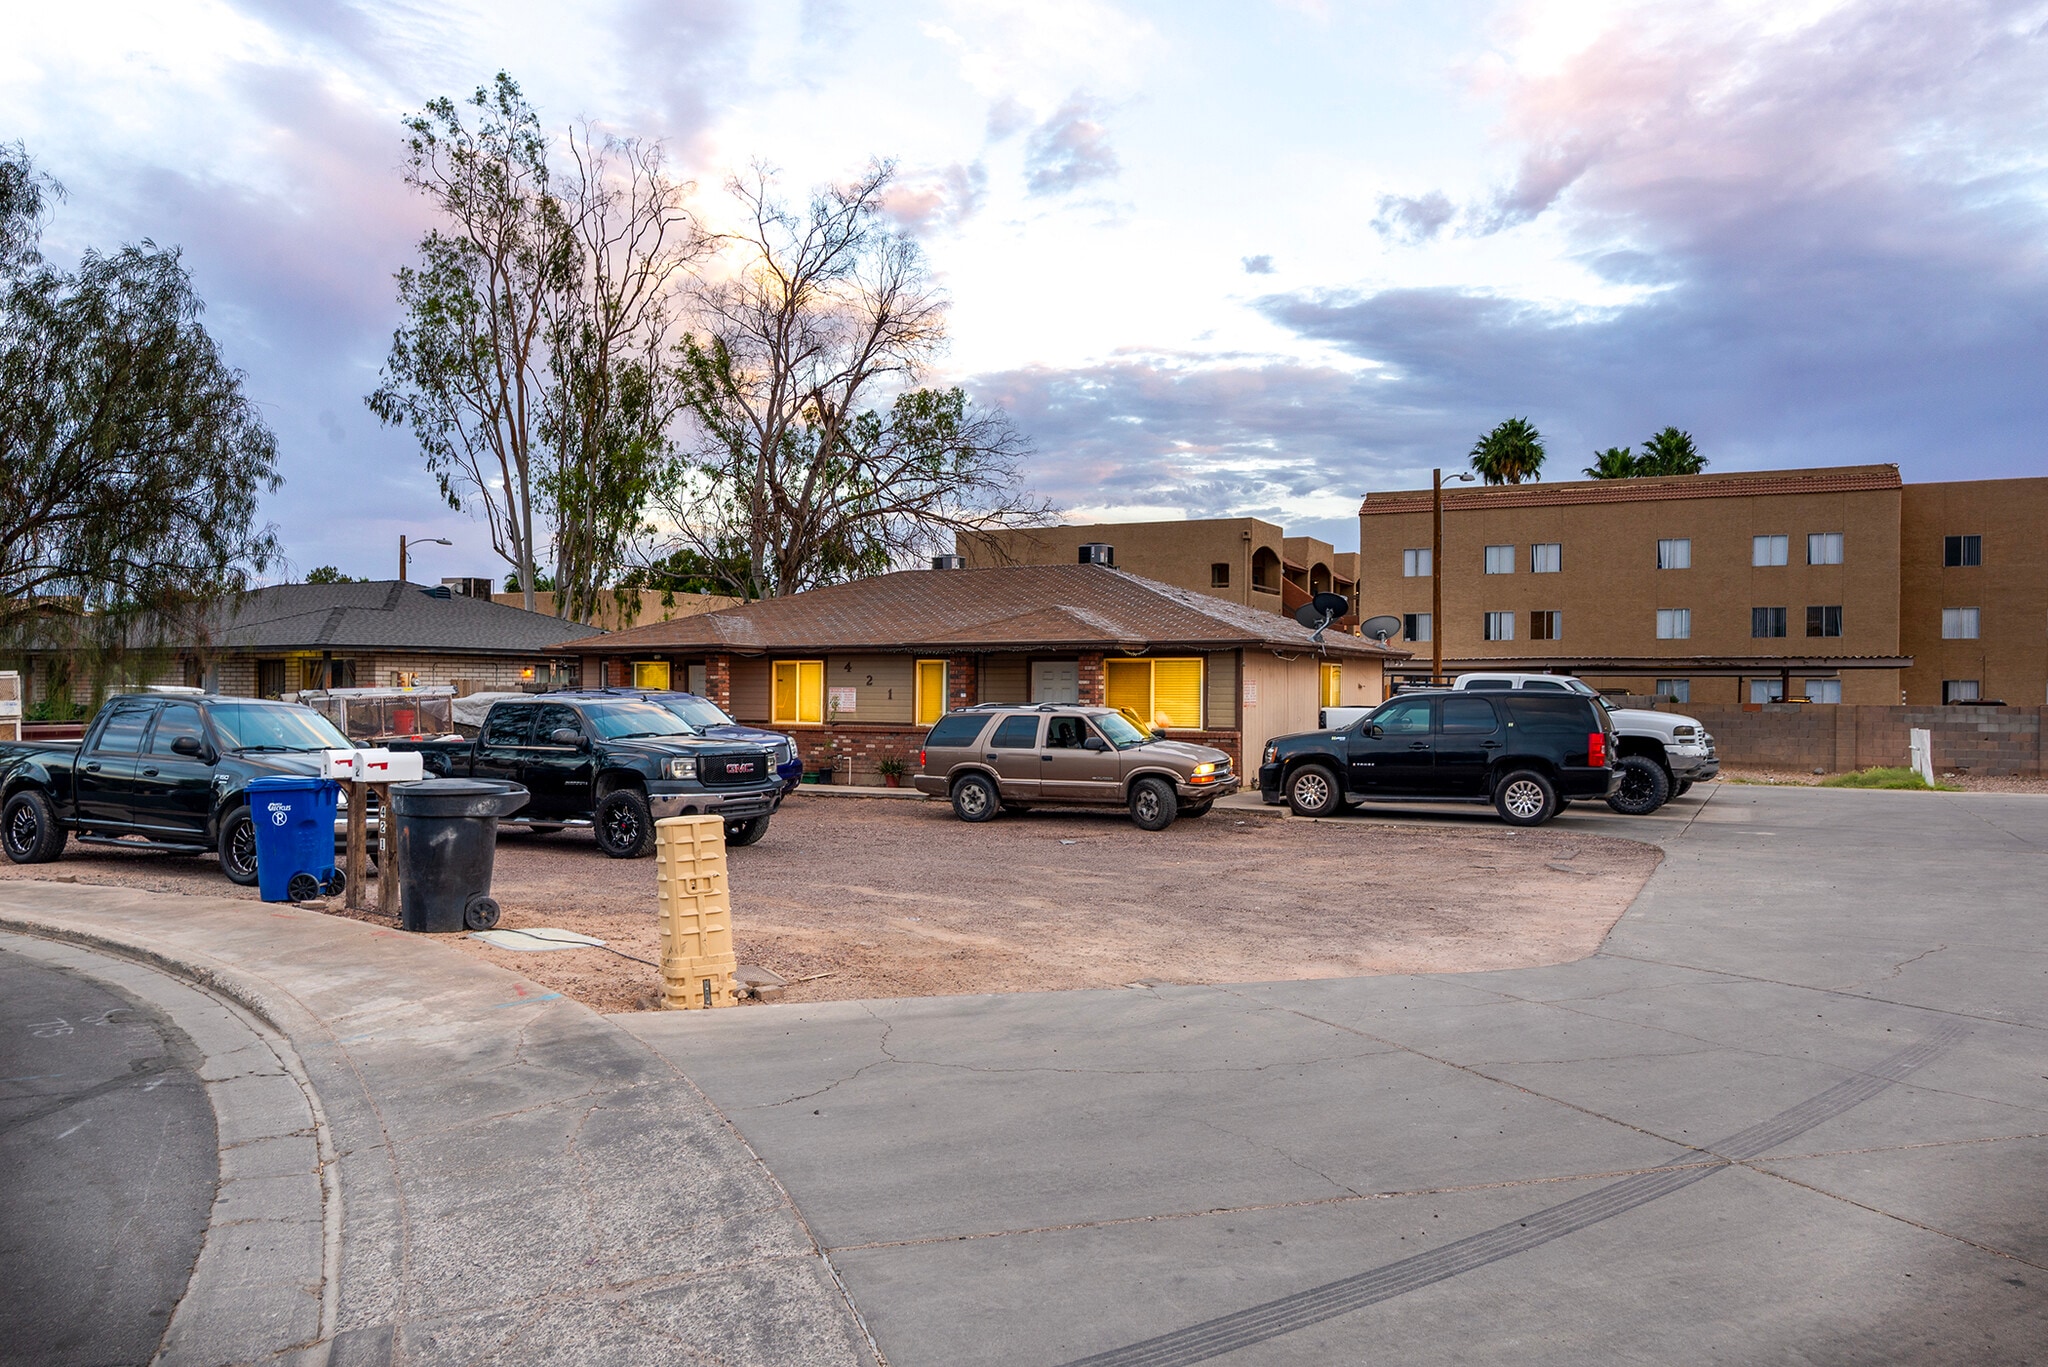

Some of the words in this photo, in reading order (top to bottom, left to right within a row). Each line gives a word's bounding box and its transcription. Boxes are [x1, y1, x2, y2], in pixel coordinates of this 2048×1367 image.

[844, 662, 852, 672] 4
[866, 675, 873, 686] 2
[726, 763, 754, 773] GMC
